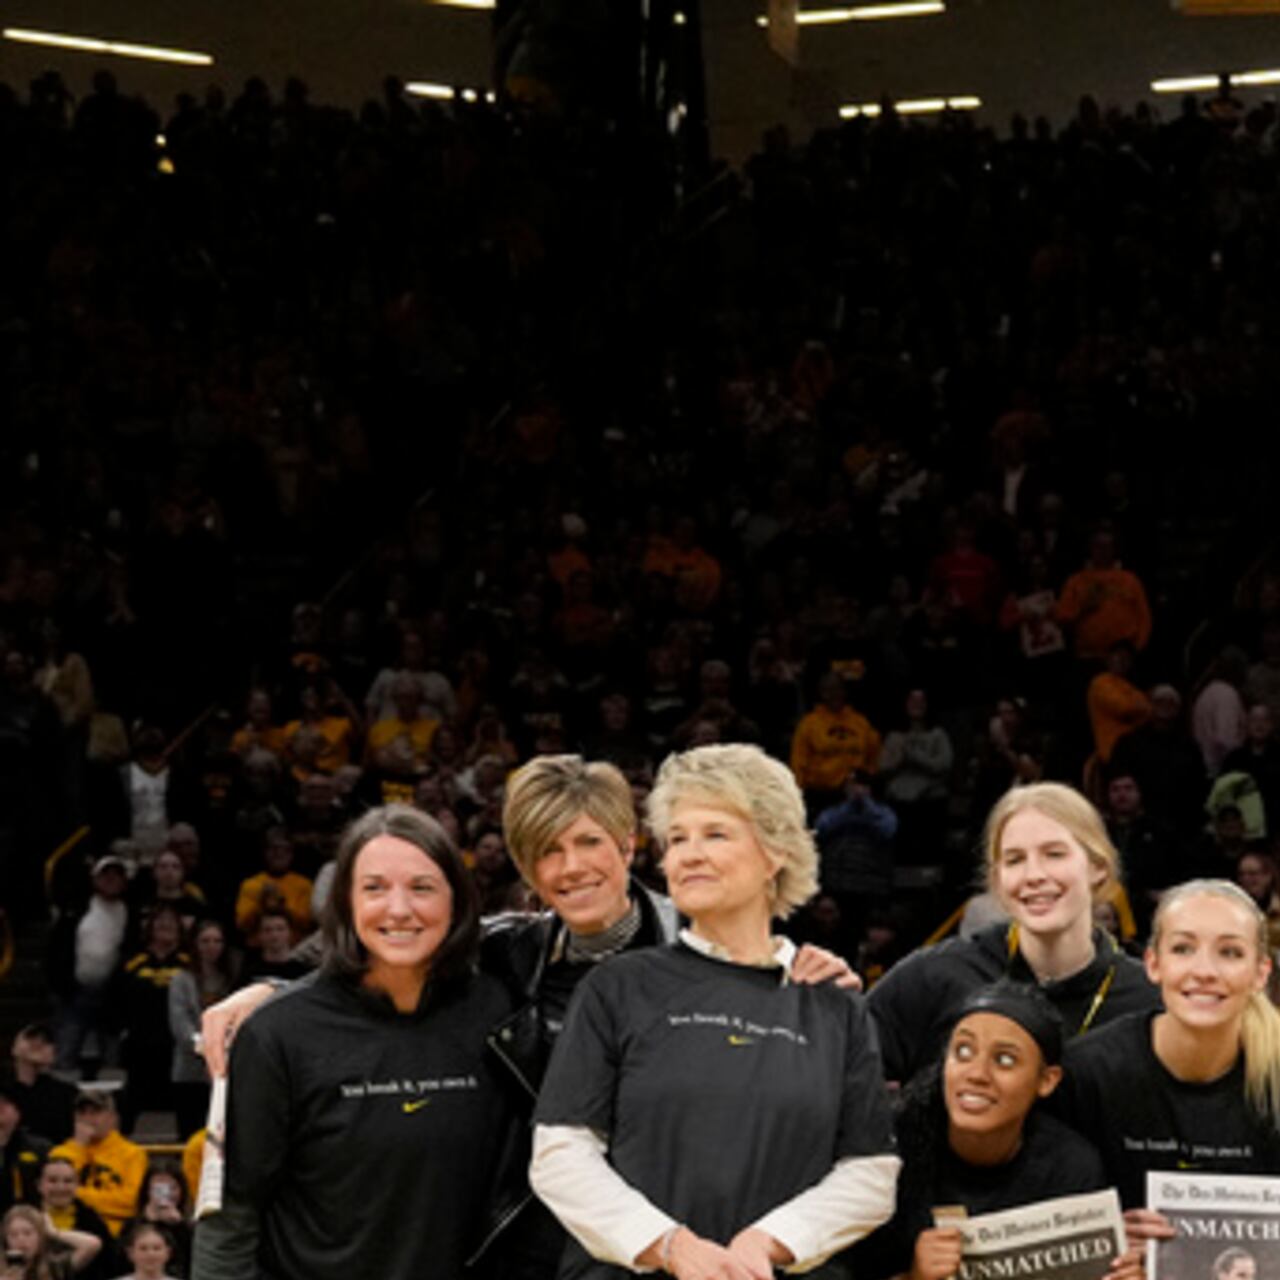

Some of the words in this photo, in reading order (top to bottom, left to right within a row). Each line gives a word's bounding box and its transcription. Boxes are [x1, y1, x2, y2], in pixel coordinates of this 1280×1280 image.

[1160, 1183, 1185, 1201] The
[1187, 1184, 1212, 1200] Des
[1213, 1186, 1259, 1203] Moines
[977, 1225, 1002, 1244] Des
[1003, 1219, 1051, 1240] Moines
[1052, 1206, 1108, 1230] Register
[959, 1236, 1113, 1280] UNMATCHED
